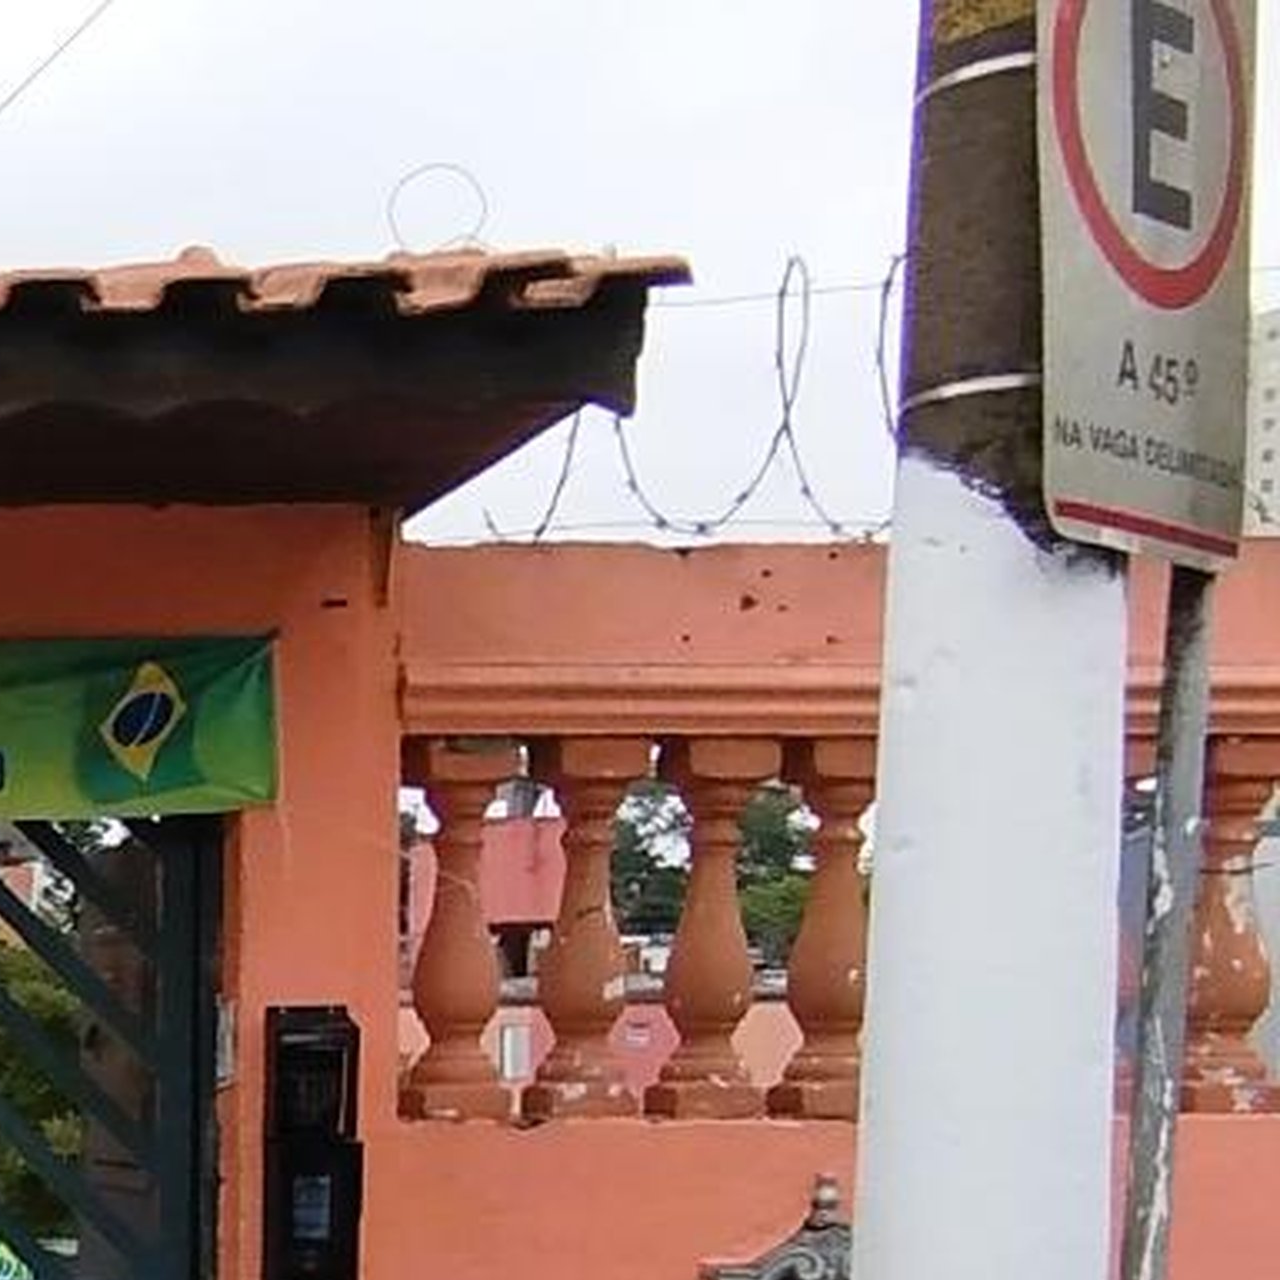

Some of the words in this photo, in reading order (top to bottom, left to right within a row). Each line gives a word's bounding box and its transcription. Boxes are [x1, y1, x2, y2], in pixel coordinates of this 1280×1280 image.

[1132, 0, 1194, 231] E
[1117, 339, 1139, 391] A
[1055, 413, 1083, 450] NA
[1088, 421, 1138, 459] VAGA
